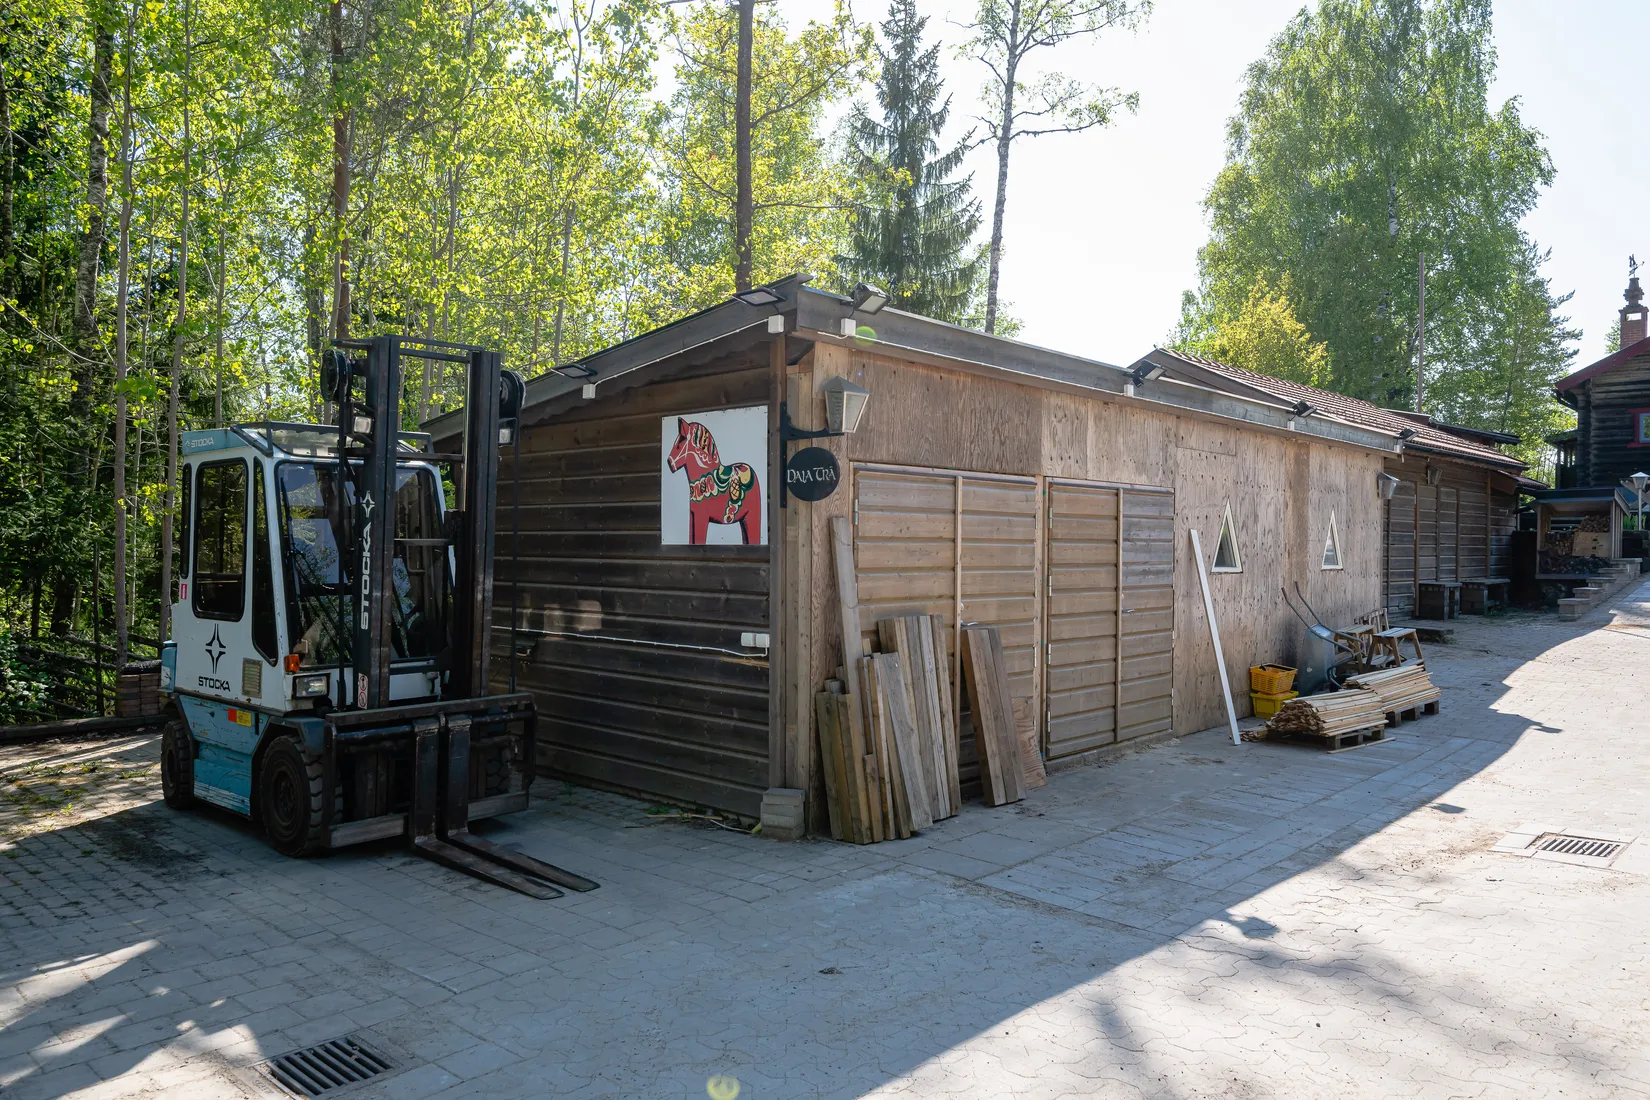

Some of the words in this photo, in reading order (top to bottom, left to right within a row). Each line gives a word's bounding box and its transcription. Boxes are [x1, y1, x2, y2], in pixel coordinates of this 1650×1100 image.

[191, 437, 214, 448] STOCKA
[360, 522, 372, 631] STOCKA
[198, 676, 231, 692] STOCKA
